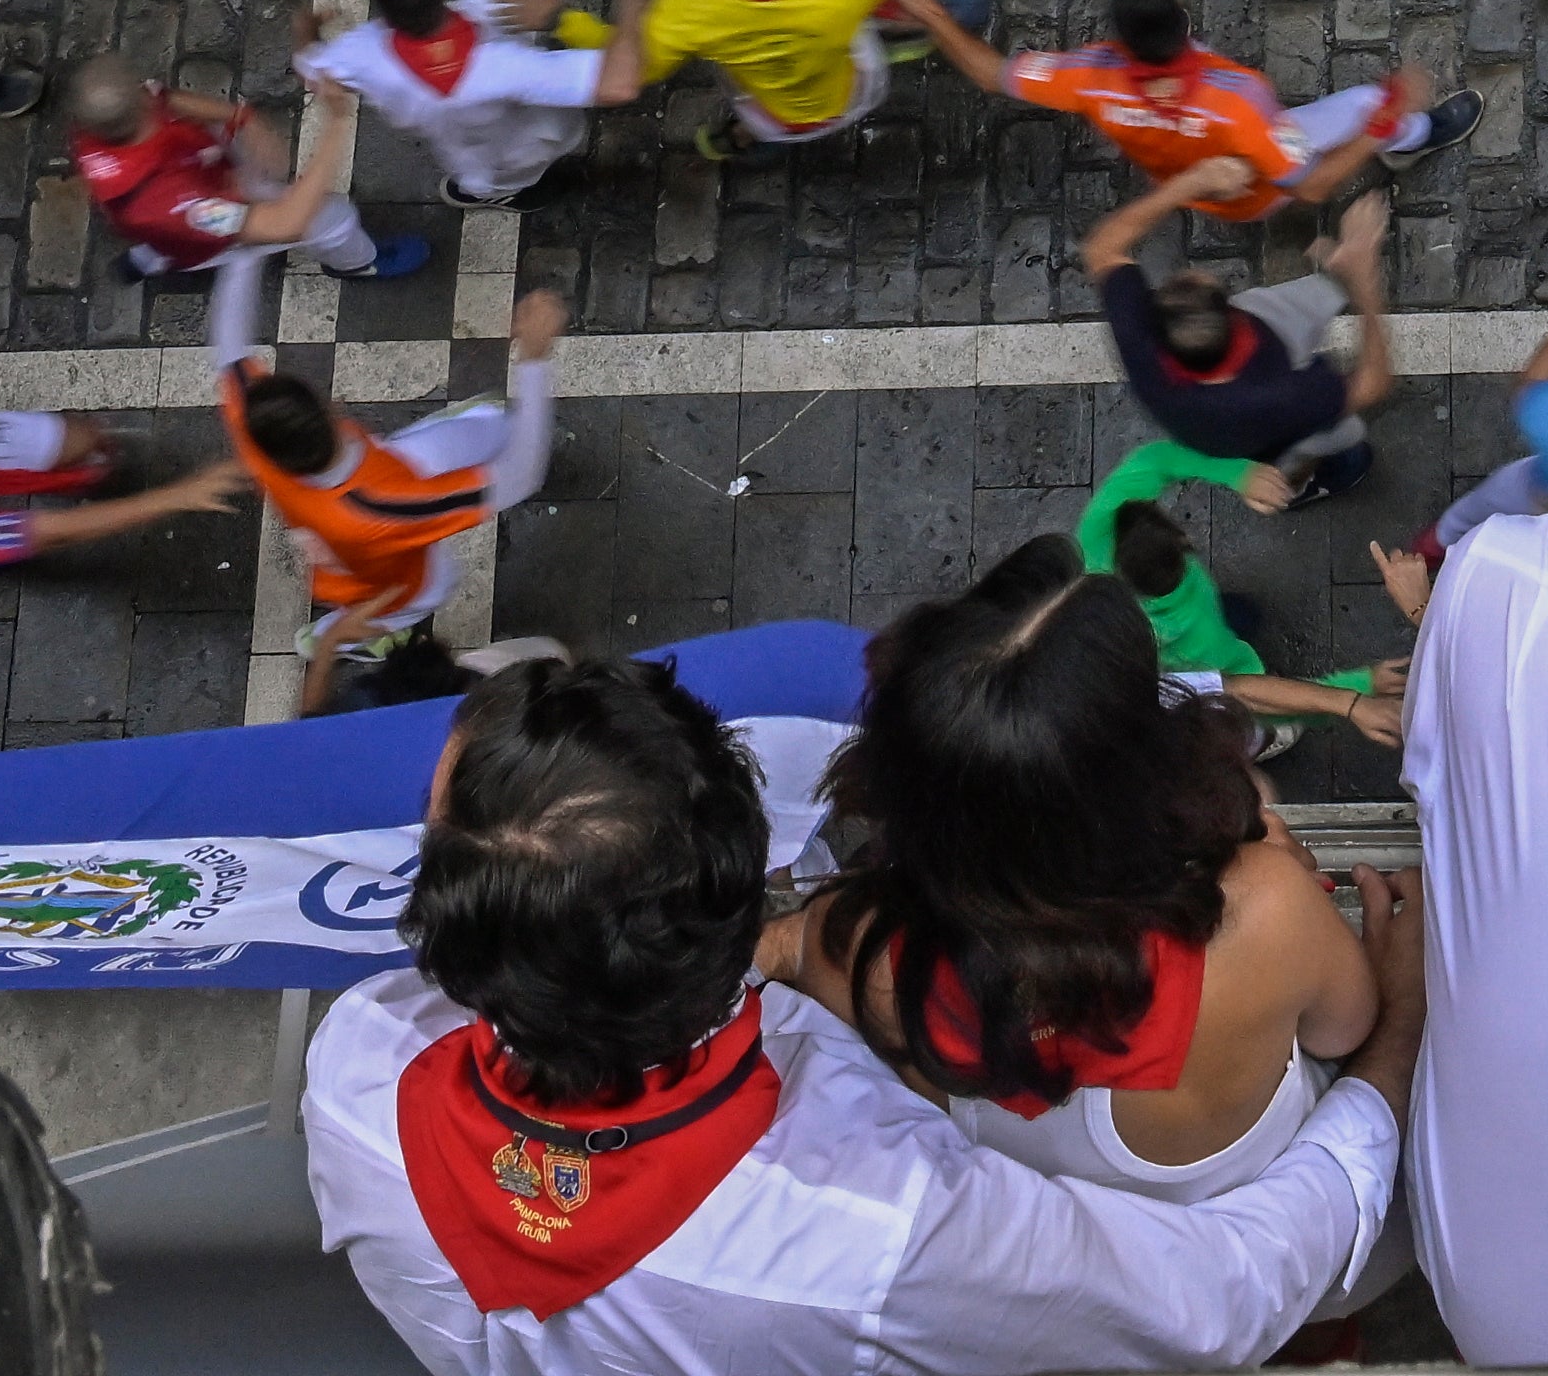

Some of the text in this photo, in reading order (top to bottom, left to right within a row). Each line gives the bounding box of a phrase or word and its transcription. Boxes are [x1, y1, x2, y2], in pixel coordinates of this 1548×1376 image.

[172, 844, 249, 932] REPUBLICA DE
[509, 1198, 572, 1229] PAMPLONA
[517, 1221, 551, 1243] IRUÑA
